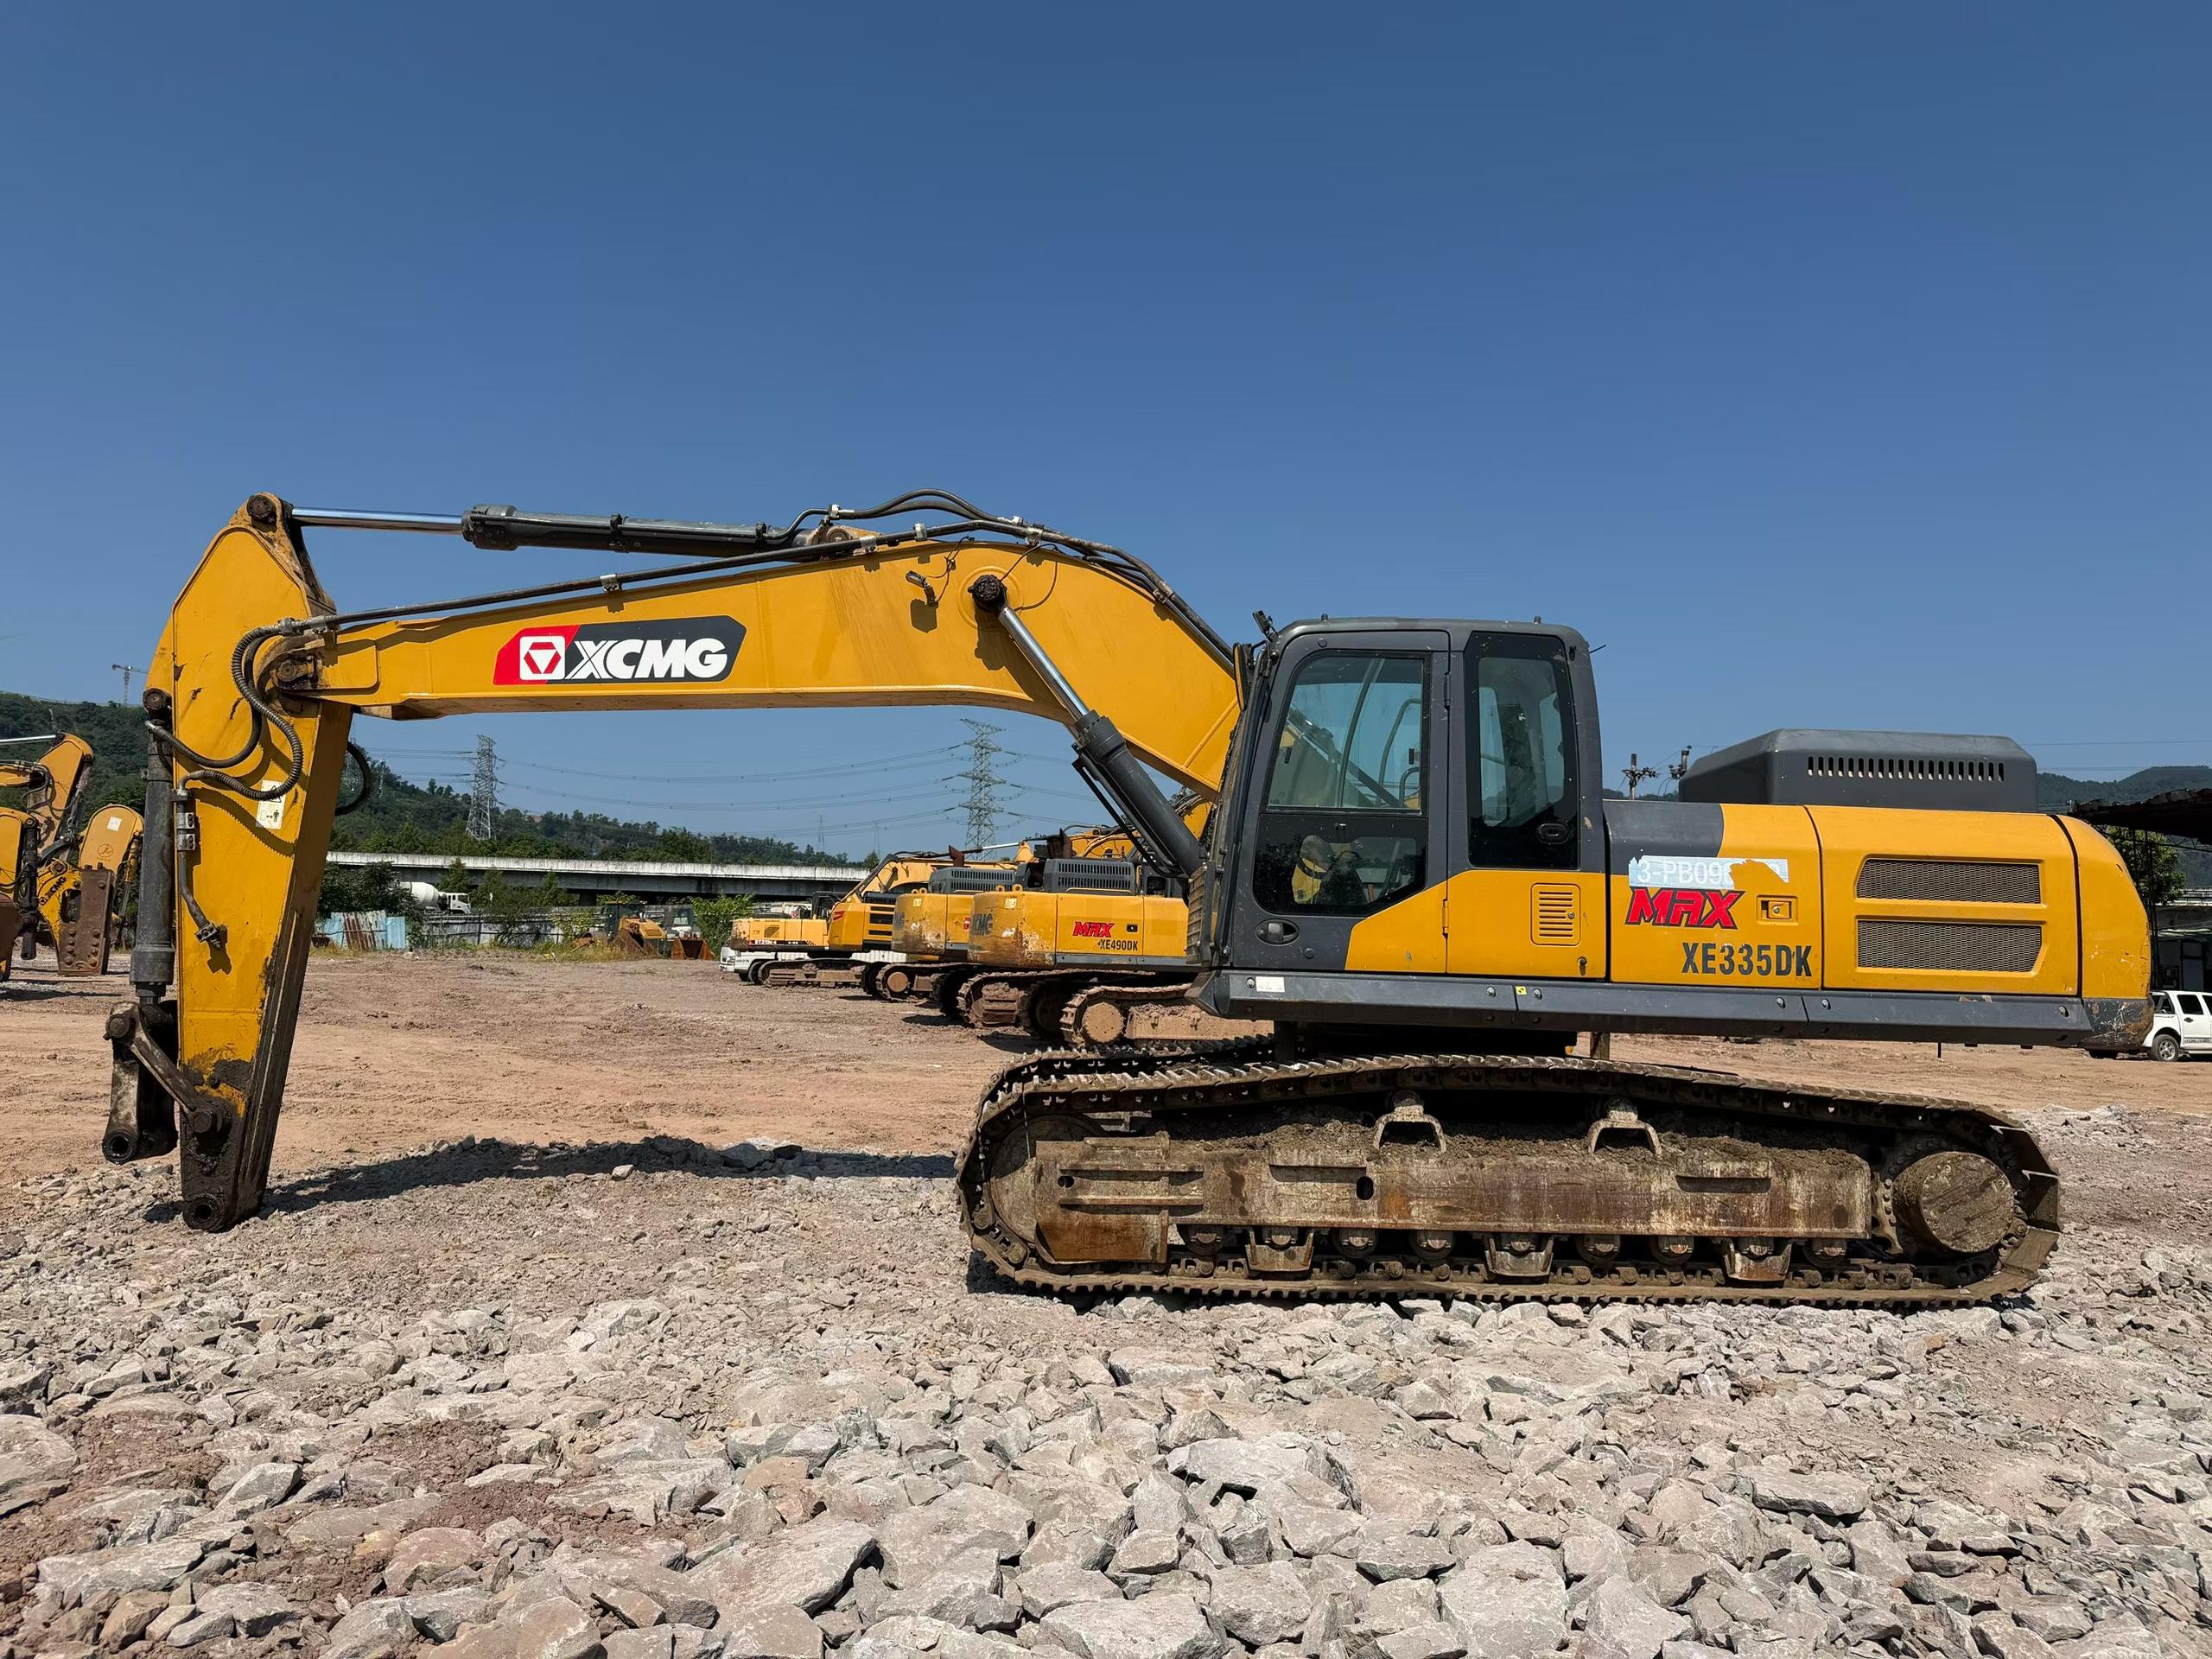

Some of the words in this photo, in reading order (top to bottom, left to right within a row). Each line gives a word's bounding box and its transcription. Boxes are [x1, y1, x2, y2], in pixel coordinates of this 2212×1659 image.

[564, 638, 728, 679] XCMG
[44, 875, 67, 899] XCMG
[1625, 886, 1746, 930] MAX
[1072, 921, 1115, 938] MAX
[1099, 938, 1139, 951] XE490DK
[1681, 941, 1812, 977] XE335DK
